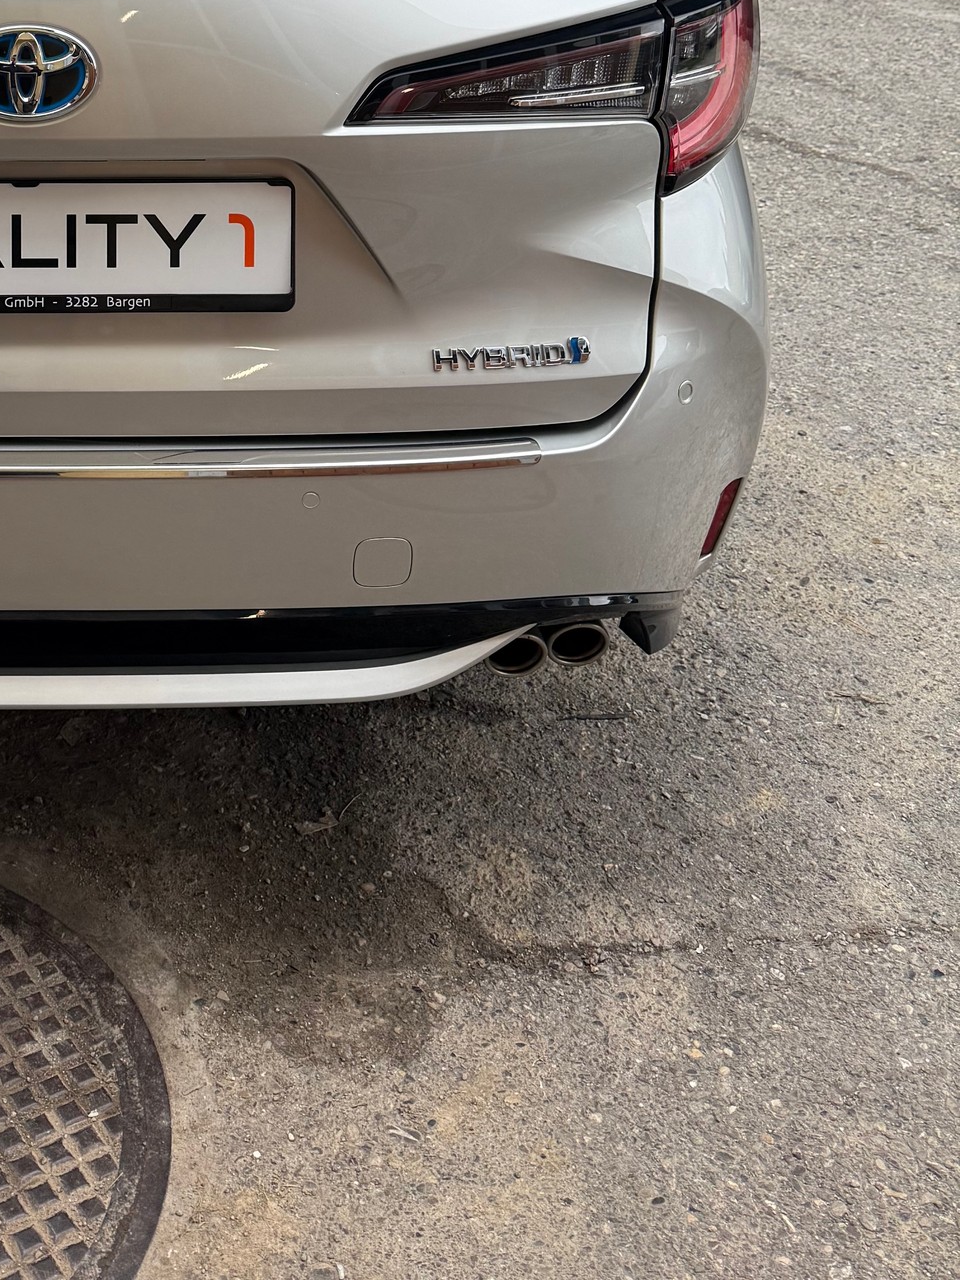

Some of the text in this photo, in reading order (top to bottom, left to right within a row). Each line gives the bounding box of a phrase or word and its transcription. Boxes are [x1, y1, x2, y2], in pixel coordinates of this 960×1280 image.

[228, 213, 255, 268] 1
[4, 296, 46, 308] GmbH
[65, 296, 99, 308] 3282
[106, 296, 151, 310] Bargen
[431, 343, 566, 371] HYBRID
